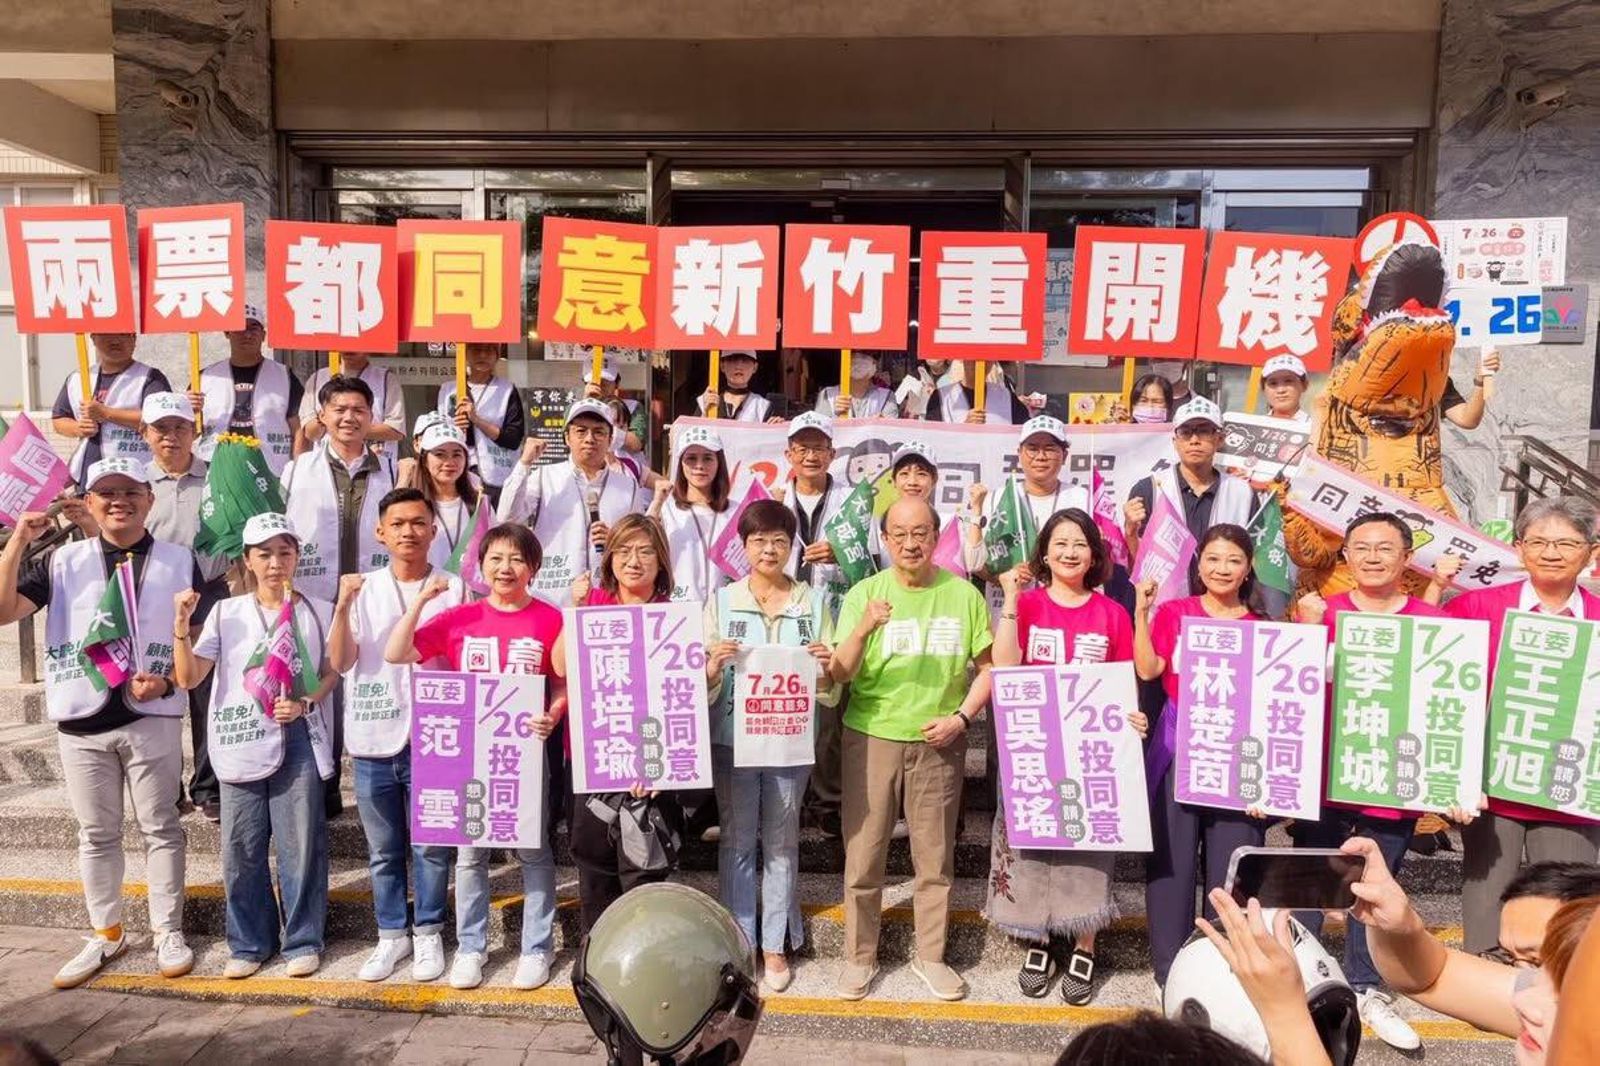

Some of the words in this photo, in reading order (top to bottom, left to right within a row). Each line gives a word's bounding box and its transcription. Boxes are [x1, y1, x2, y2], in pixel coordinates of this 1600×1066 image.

[587, 618, 631, 641] 立委
[1193, 629, 1238, 650] 立委
[1256, 628, 1319, 695] 7/26
[1349, 626, 1396, 648] 立委
[1415, 624, 1482, 691] 7/26
[1516, 627, 1571, 653] 立委
[419, 681, 464, 701] 立委
[589, 645, 638, 782] 陳培瑜
[661, 677, 701, 782] 投同意
[1001, 681, 1043, 702] 立委
[1060, 674, 1124, 732] 7/26
[1188, 657, 1236, 797] 林楚茵
[1340, 654, 1394, 795] 李坤城
[1488, 654, 1563, 795] 王正旭
[487, 744, 521, 843] 投同意
[1005, 711, 1058, 839] 吳思瑤
[1078, 741, 1123, 844] 投同意
[1265, 699, 1305, 811] 投同意
[1424, 695, 1467, 806] 投同意
